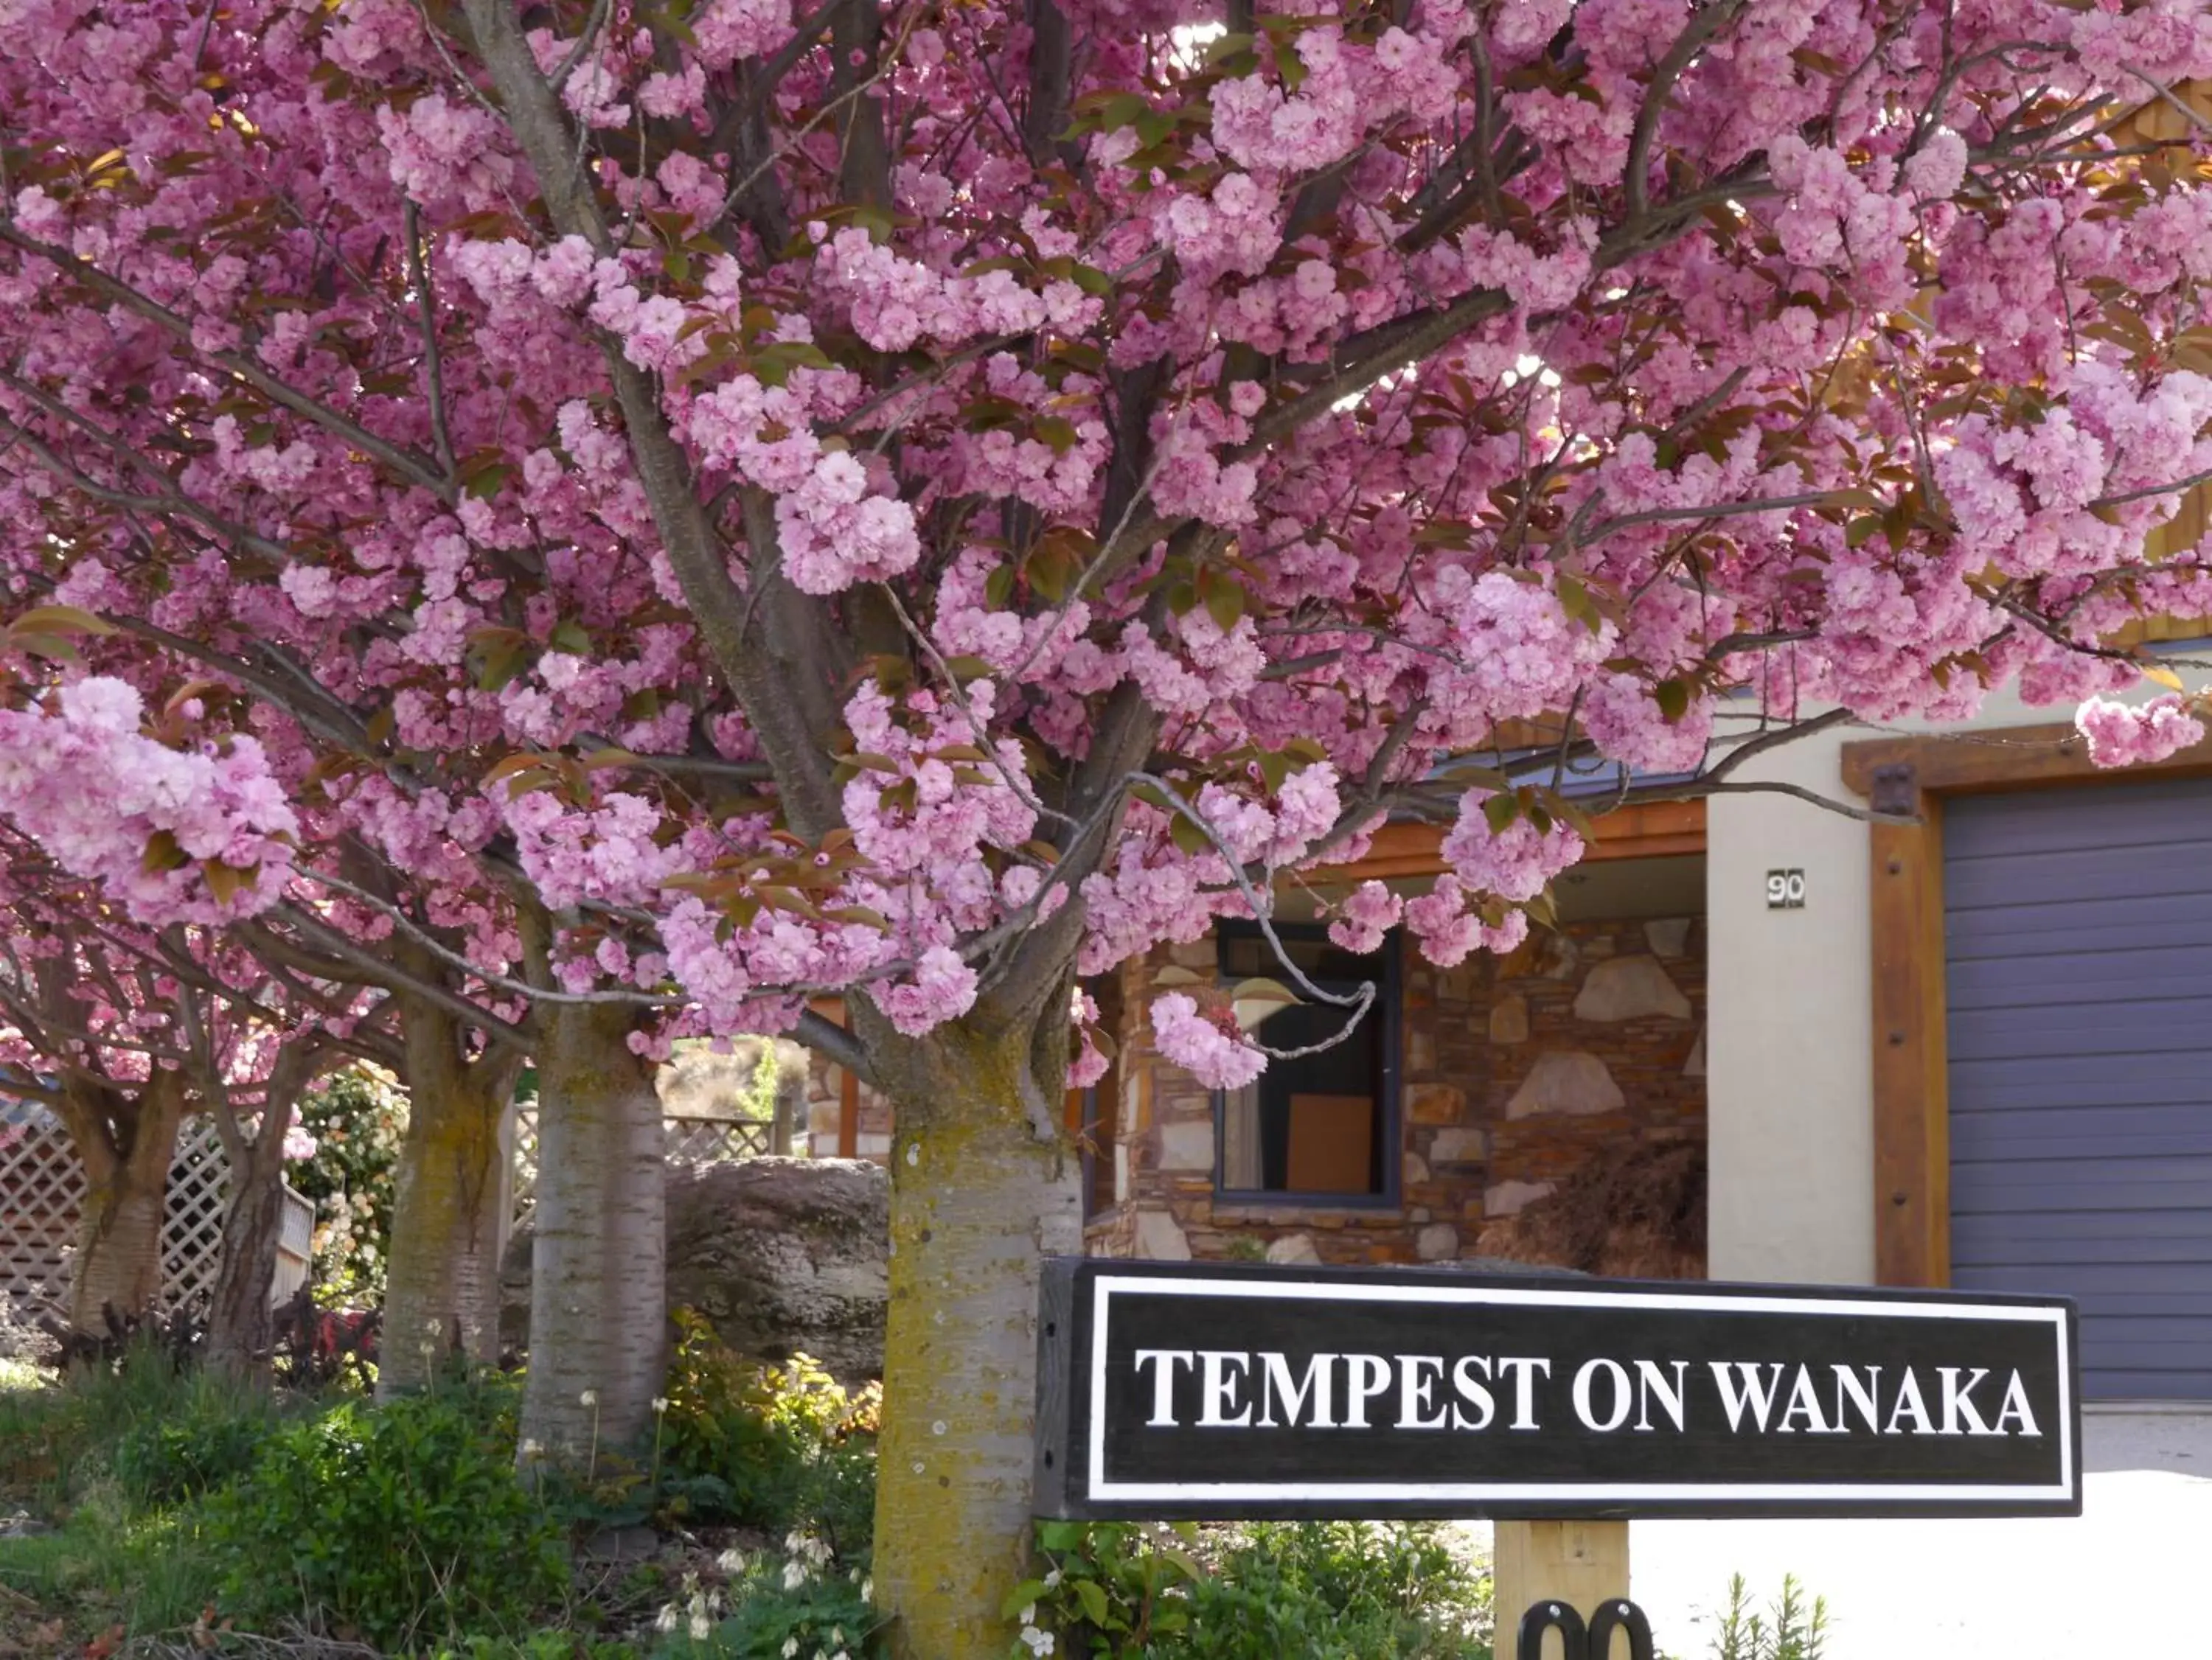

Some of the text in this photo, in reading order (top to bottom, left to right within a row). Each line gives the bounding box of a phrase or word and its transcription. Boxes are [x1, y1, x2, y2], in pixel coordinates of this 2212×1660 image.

[1767, 873, 1805, 900] 90
[1134, 1349, 2043, 1437] TEMPEST ON WANAKA
